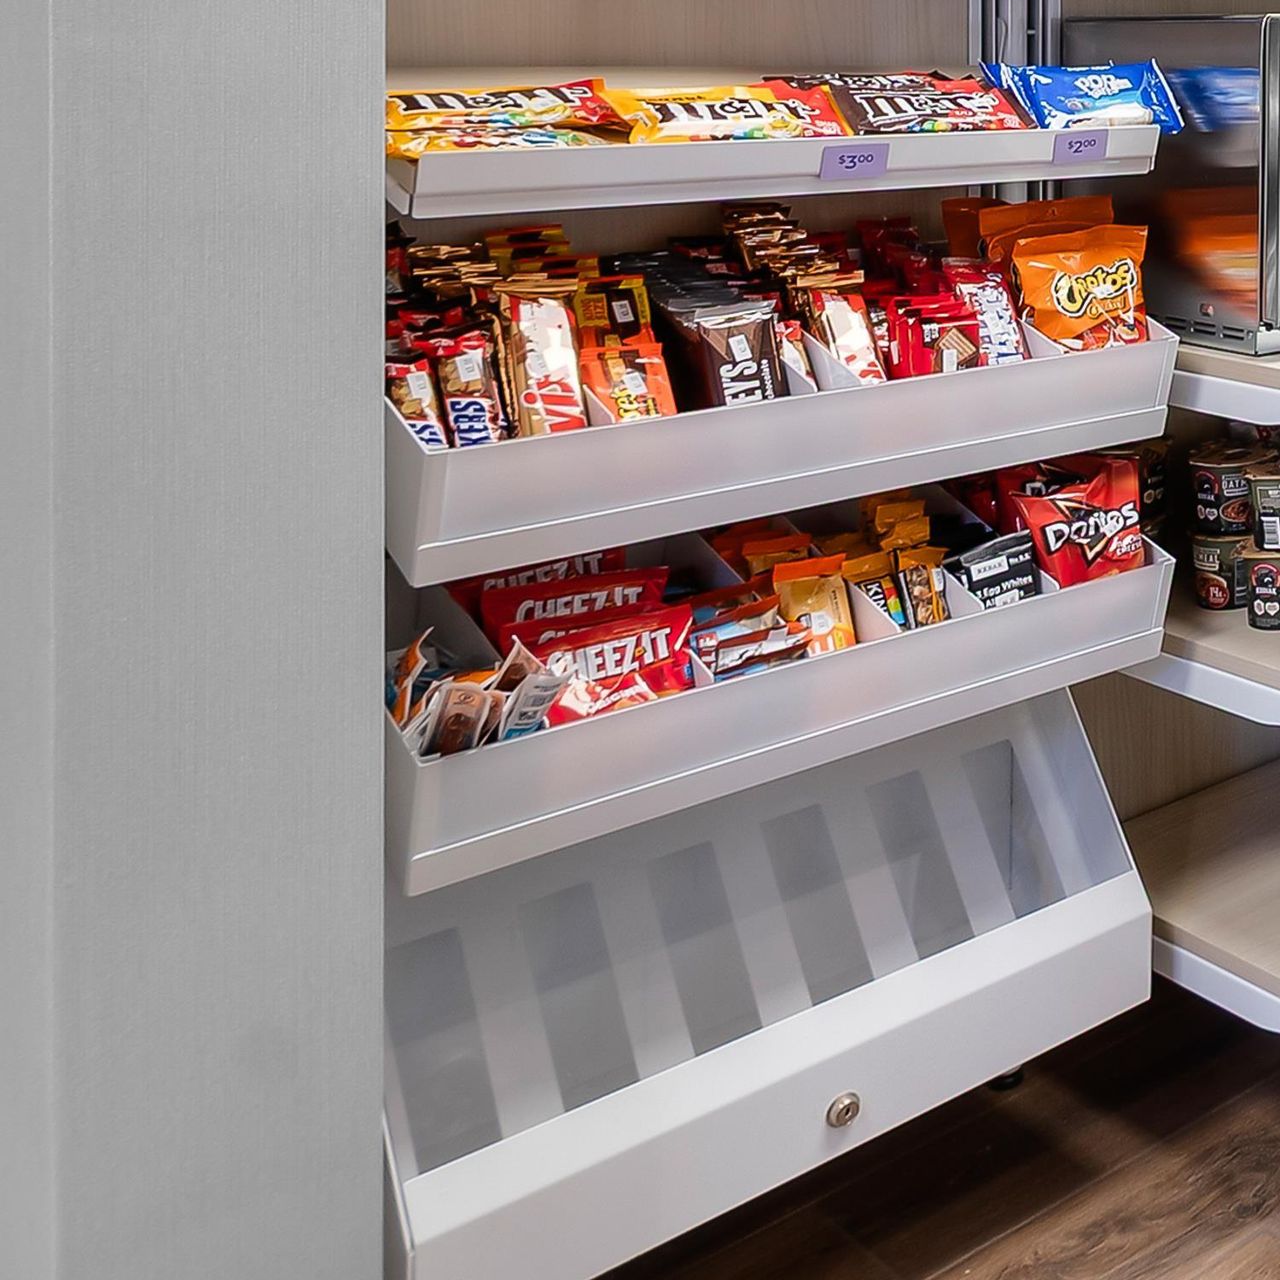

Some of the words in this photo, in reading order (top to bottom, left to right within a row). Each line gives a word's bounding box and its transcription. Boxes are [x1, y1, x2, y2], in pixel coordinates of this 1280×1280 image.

[1044, 502, 1140, 553] Doritos
[984, 586, 1001, 599] Egg
[1002, 575, 1033, 591] Whites
